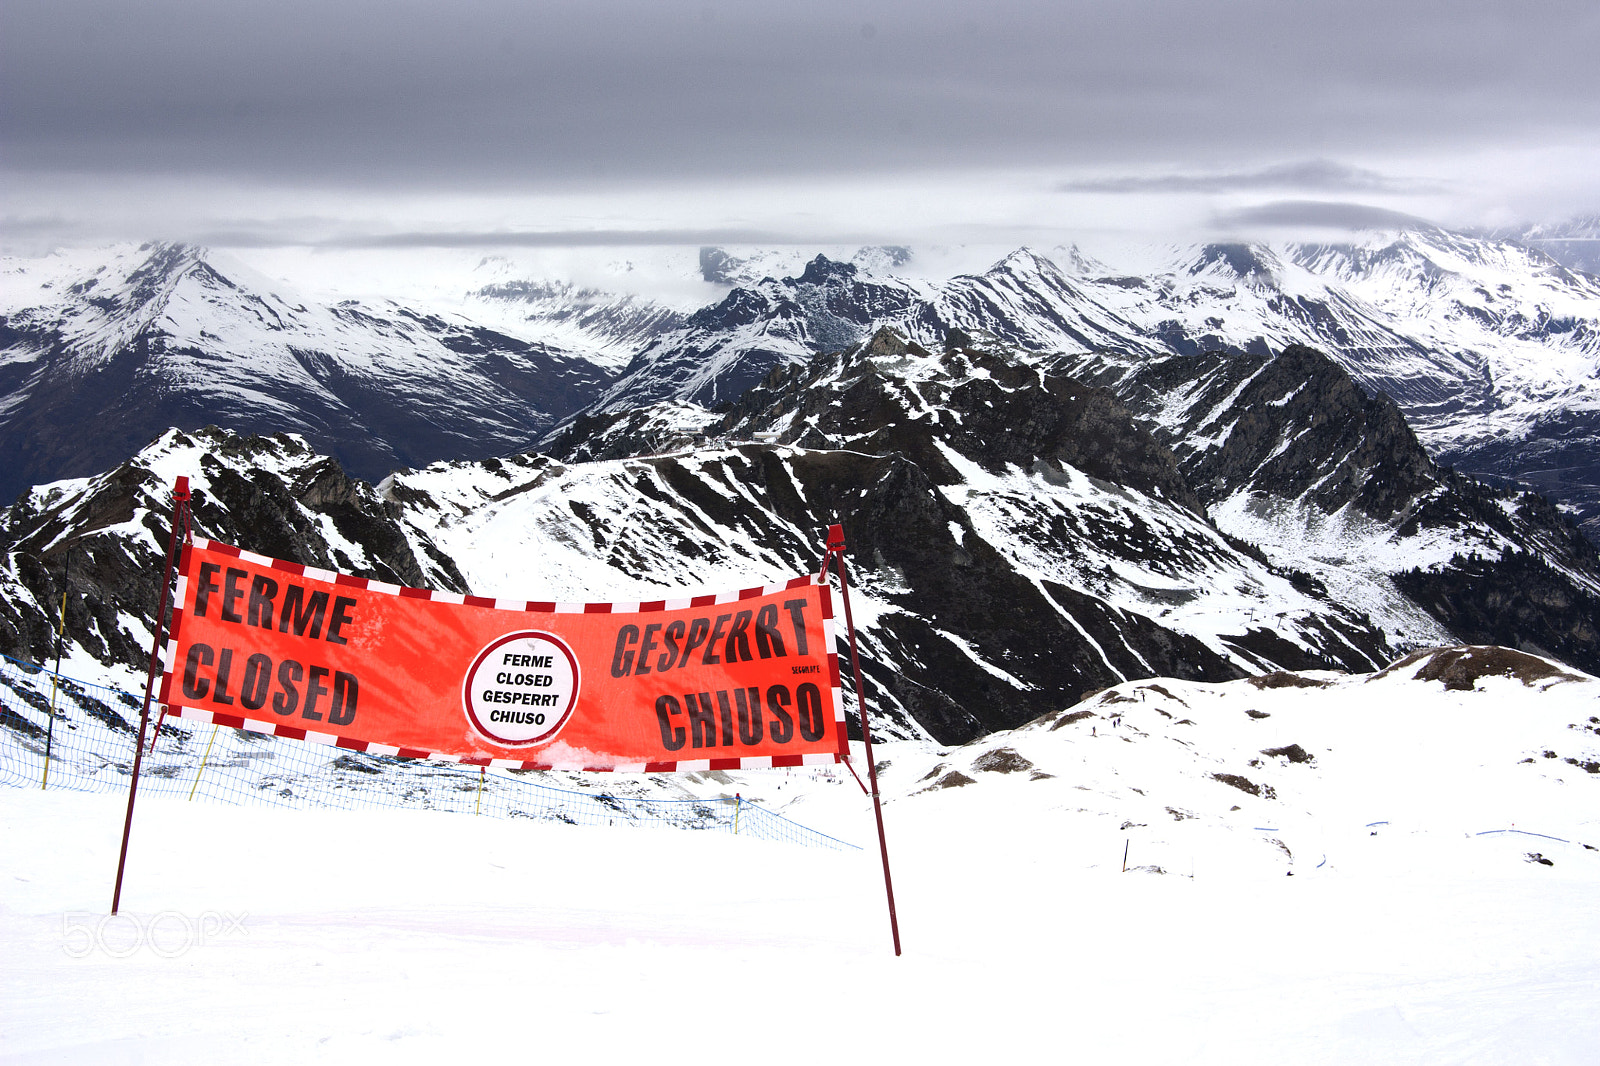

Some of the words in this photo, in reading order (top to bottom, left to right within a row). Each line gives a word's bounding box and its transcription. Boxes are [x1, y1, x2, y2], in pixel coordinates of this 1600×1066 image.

[194, 562, 357, 645] FERME
[611, 598, 808, 678] GESPERRT
[496, 672, 553, 687] CLOSED
[503, 653, 553, 668] FERME
[182, 643, 359, 726] CLOSED
[483, 690, 559, 706] GESPERRT
[490, 709, 545, 725] CHIUSO
[655, 683, 825, 751] CHIUSO
